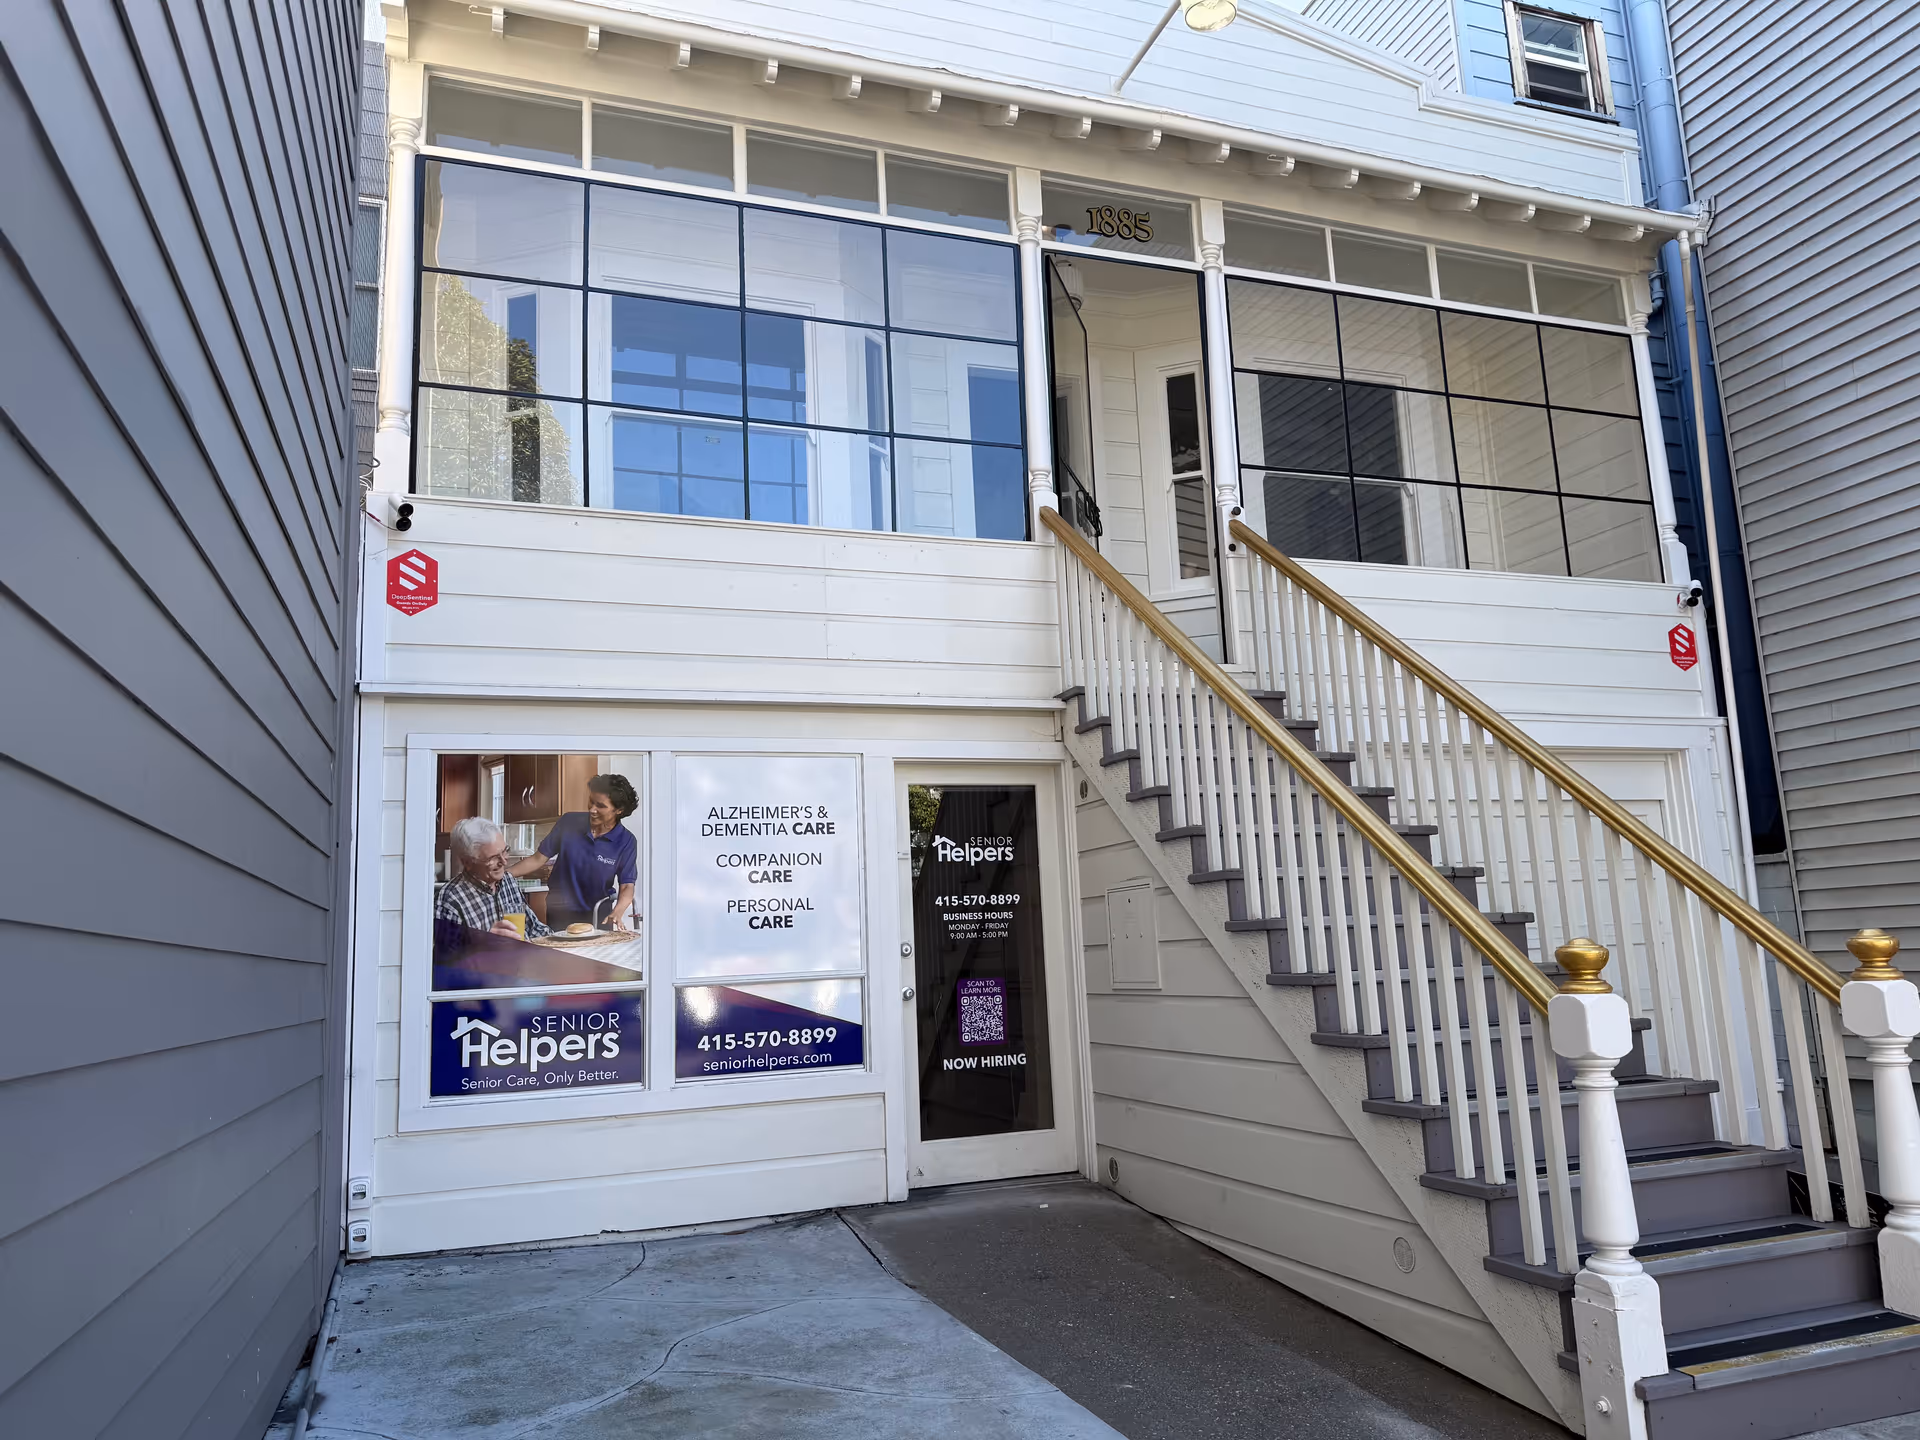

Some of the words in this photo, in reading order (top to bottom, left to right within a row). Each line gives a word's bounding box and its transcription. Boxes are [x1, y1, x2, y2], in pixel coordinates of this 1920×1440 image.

[1086, 205, 1154, 242] 1885
[707, 806, 813, 820] ALZHEIMER'S
[817, 806, 828, 819] &
[701, 823, 788, 836] DEMENTIA
[792, 822, 836, 835] CARE
[970, 836, 1012, 846] SENIOR
[716, 853, 822, 867] COMPANION
[937, 842, 1014, 866] Helpers
[748, 870, 793, 883] CARE
[727, 898, 814, 913] PERSONAL
[935, 894, 1020, 906] 415-570-8899
[748, 915, 793, 929] CARE
[943, 912, 983, 920] BUSINESS
[984, 911, 1013, 919] HOURS
[531, 1013, 620, 1034] SENIOR
[697, 1027, 837, 1051] 415-570-8899
[461, 1028, 620, 1072] Helpers
[703, 1053, 832, 1071] seniorhelpers.com
[943, 1057, 978, 1070] NOW
[981, 1053, 1027, 1068] HIRING
[461, 1078, 503, 1090] Senior
[506, 1075, 540, 1087] Care,
[544, 1071, 575, 1086] Only
[578, 1070, 619, 1082] Better.
